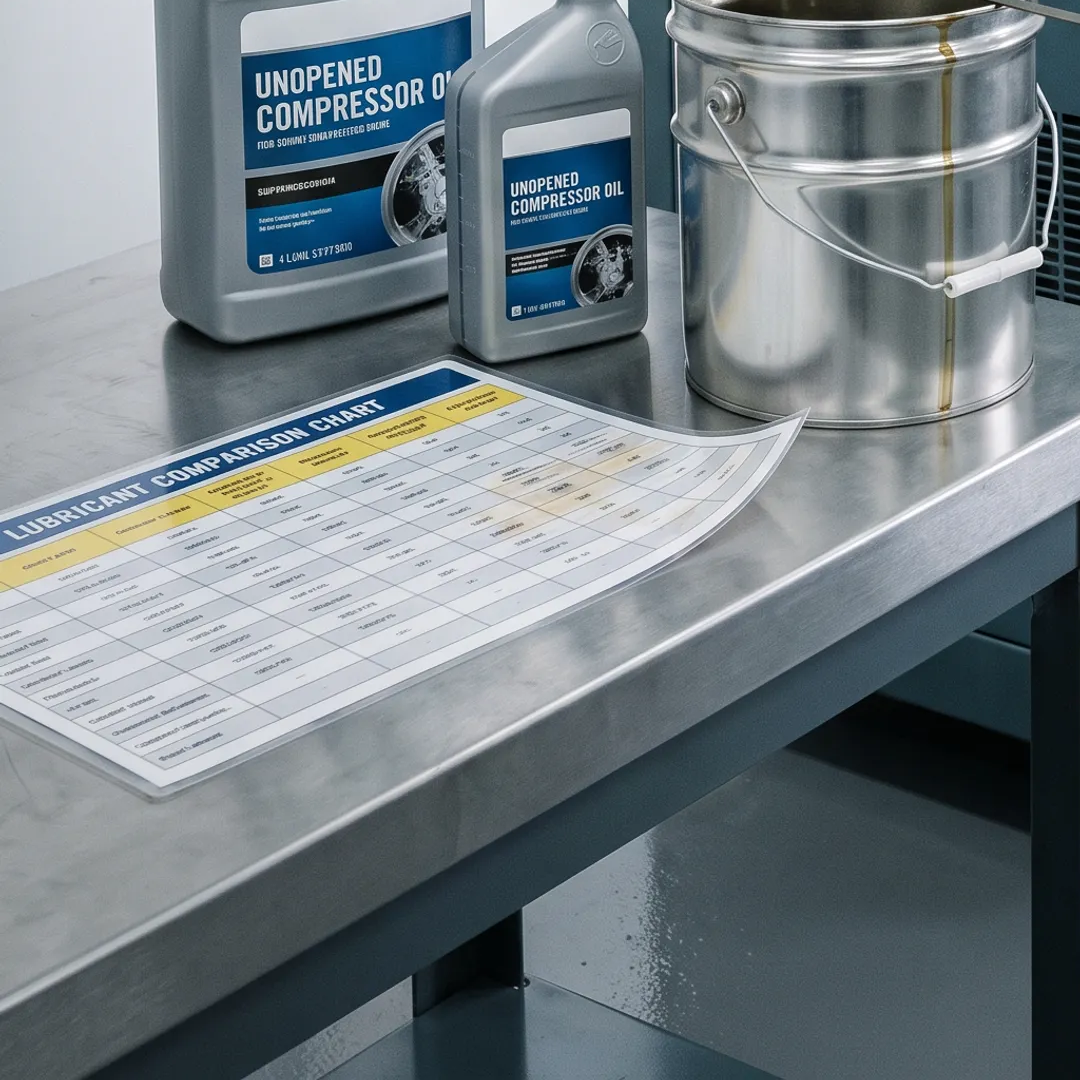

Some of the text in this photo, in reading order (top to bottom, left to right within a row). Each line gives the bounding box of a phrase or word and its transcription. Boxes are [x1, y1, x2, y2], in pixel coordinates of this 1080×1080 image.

[255, 54, 382, 99] UNOPENED
[256, 78, 425, 134] COMPRESSOR
[510, 171, 579, 198] UNOPENED
[510, 185, 601, 216] COMPRESSOR
[604, 180, 625, 198] OIL
[2, 482, 150, 541] LUBRICANT
[150, 426, 311, 489] COMPARISON
[307, 398, 386, 433] CHART
